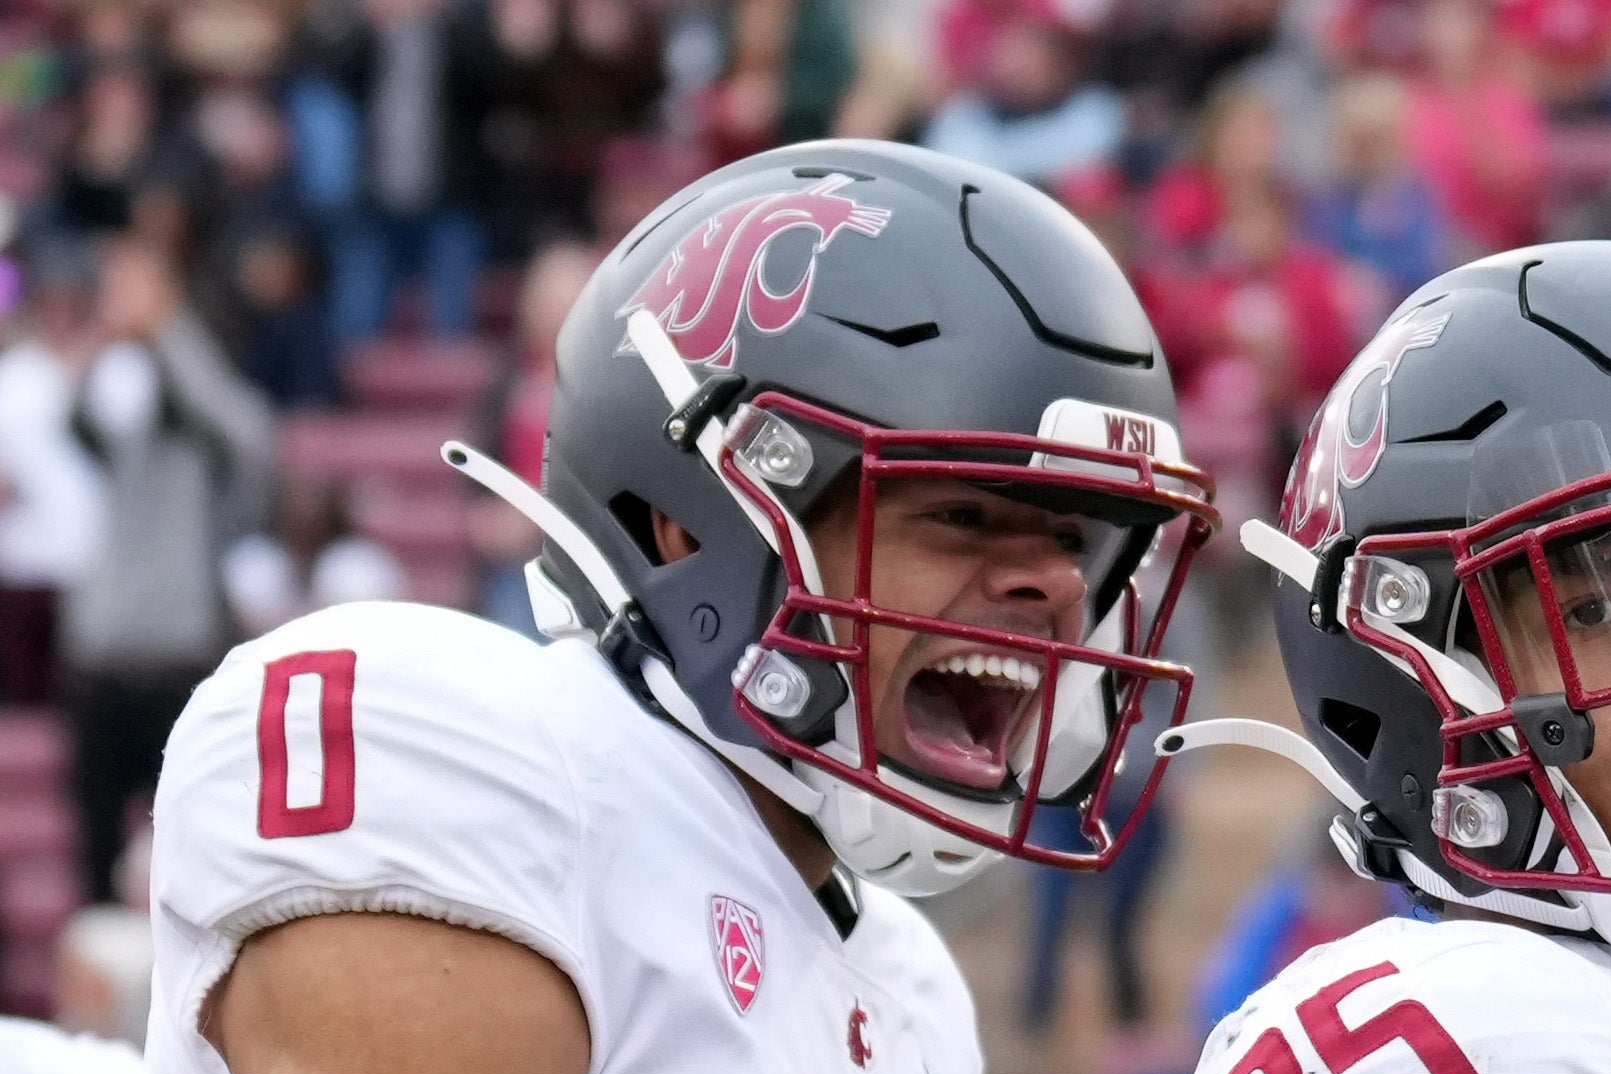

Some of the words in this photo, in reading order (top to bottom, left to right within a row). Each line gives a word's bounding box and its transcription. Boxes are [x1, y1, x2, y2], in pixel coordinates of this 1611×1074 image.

[1103, 411, 1155, 456] WSU
[256, 649, 357, 839] 0
[725, 944, 757, 992] 12
